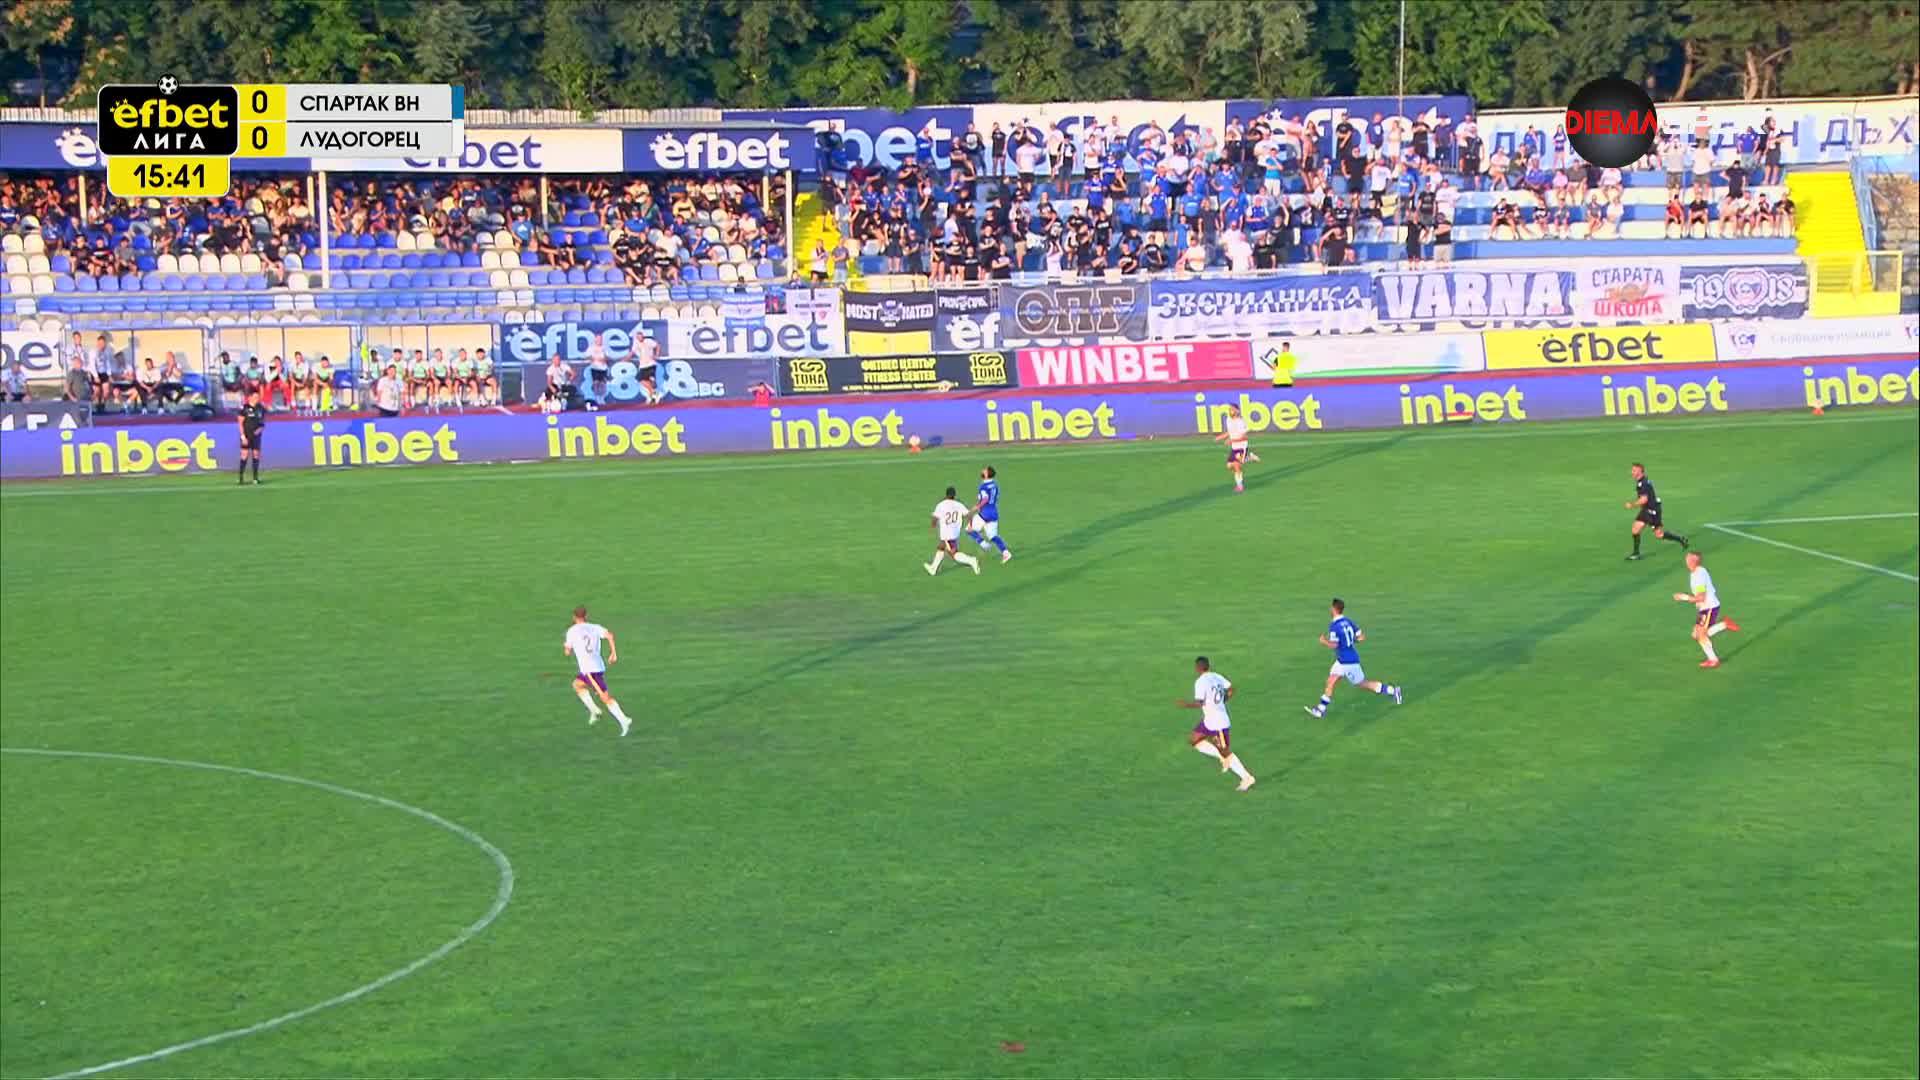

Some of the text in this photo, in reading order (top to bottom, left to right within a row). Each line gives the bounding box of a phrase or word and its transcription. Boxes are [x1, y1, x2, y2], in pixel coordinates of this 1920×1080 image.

[650, 131, 790, 170] efbet
[1379, 271, 1567, 320] VARNA
[1592, 266, 1665, 288] СТАРАТА
[1594, 300, 1665, 318] ШКОЛА
[1030, 345, 1195, 387] WINBET
[1537, 330, 1664, 363] efbet
[1399, 384, 1527, 425] inbet
[1601, 375, 1728, 415] inbet
[1803, 365, 1918, 407] inbet
[770, 408, 905, 449] inbet
[986, 400, 1117, 442] inbet
[1195, 392, 1323, 433] inbet
[61, 425, 217, 475] inbet
[312, 422, 459, 466] inbet
[546, 415, 686, 457] inbet
[945, 511, 959, 525] 20
